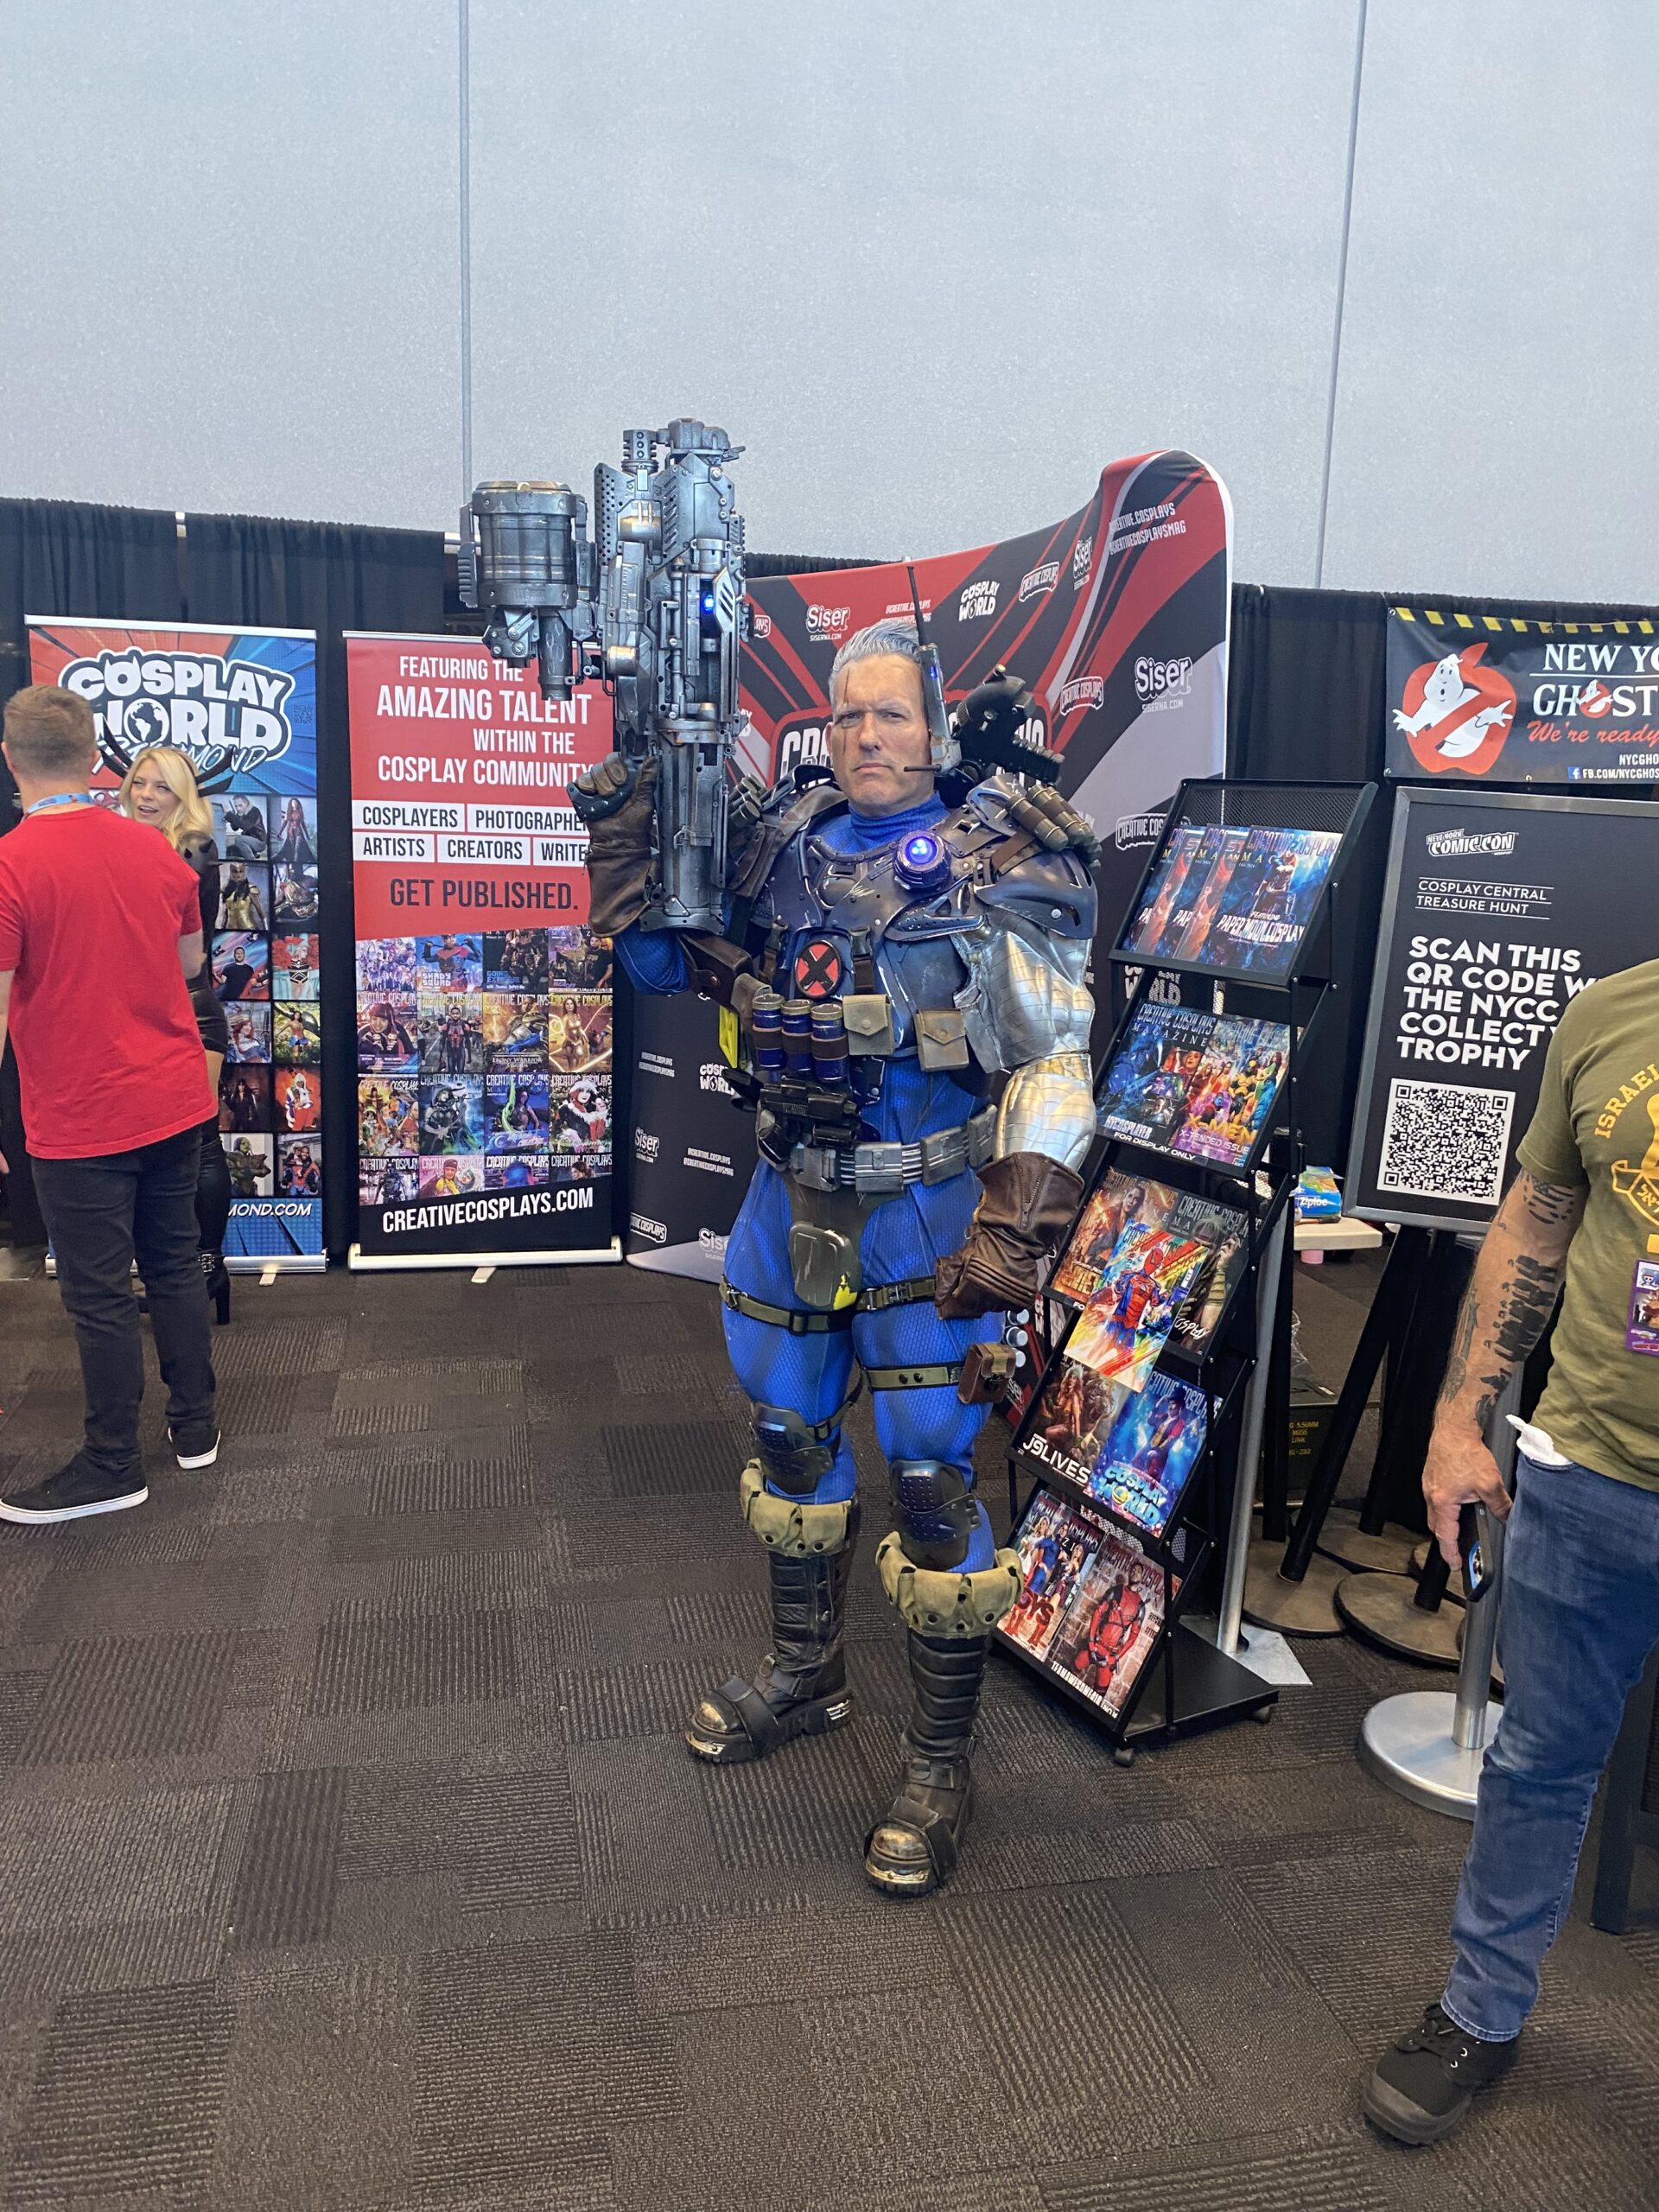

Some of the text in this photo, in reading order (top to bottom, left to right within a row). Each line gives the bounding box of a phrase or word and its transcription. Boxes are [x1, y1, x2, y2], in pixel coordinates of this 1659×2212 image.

[961, 581, 1000, 603] COSPLAY
[807, 606, 849, 632] Siser
[399, 656, 524, 682] FEATURING THE
[1542, 643, 1623, 672] NEW
[67, 658, 286, 709] COSPLAY
[1136, 659, 1191, 692] Siser
[377, 684, 592, 724] AMAZING TALENT
[473, 728, 575, 754] WITHIN THE
[1527, 720, 1593, 743] We're
[378, 755, 467, 784] COSPLAY
[362, 806, 588, 831] COSPLAYERS PHOTOGRAPHE
[1118, 818, 1147, 842] CREATIVE
[363, 836, 591, 862] ARTISTS CREATORS WRITE
[1427, 830, 1464, 843] NEW YORK
[1431, 834, 1513, 855] COMIC CON
[391, 878, 579, 910] GET PUBLISHED.
[1418, 880, 1547, 900] COSPLAY CENTRAL
[1416, 895, 1529, 914] TREASURE HUNT
[1408, 936, 1581, 972] SCAN THIS
[1407, 961, 1454, 987] QR
[1461, 967, 1555, 996] CODE
[1403, 986, 1560, 1022] THE NYCC
[1137, 1003, 1216, 1035] CREATIVE COSPLAYS
[1400, 1012, 1545, 1046] COLLECT
[1396, 1036, 1531, 1071] TROPHY
[635, 1128, 659, 1153] Siser
[1179, 1129, 1250, 1154] X-TENDED ISSUE
[1185, 1113, 1257, 1144] X-MEN
[1114, 1132, 1196, 1160] FOR DISPLAY ONLY
[382, 1186, 594, 1233] CREATIVECOSPLAYS.COM
